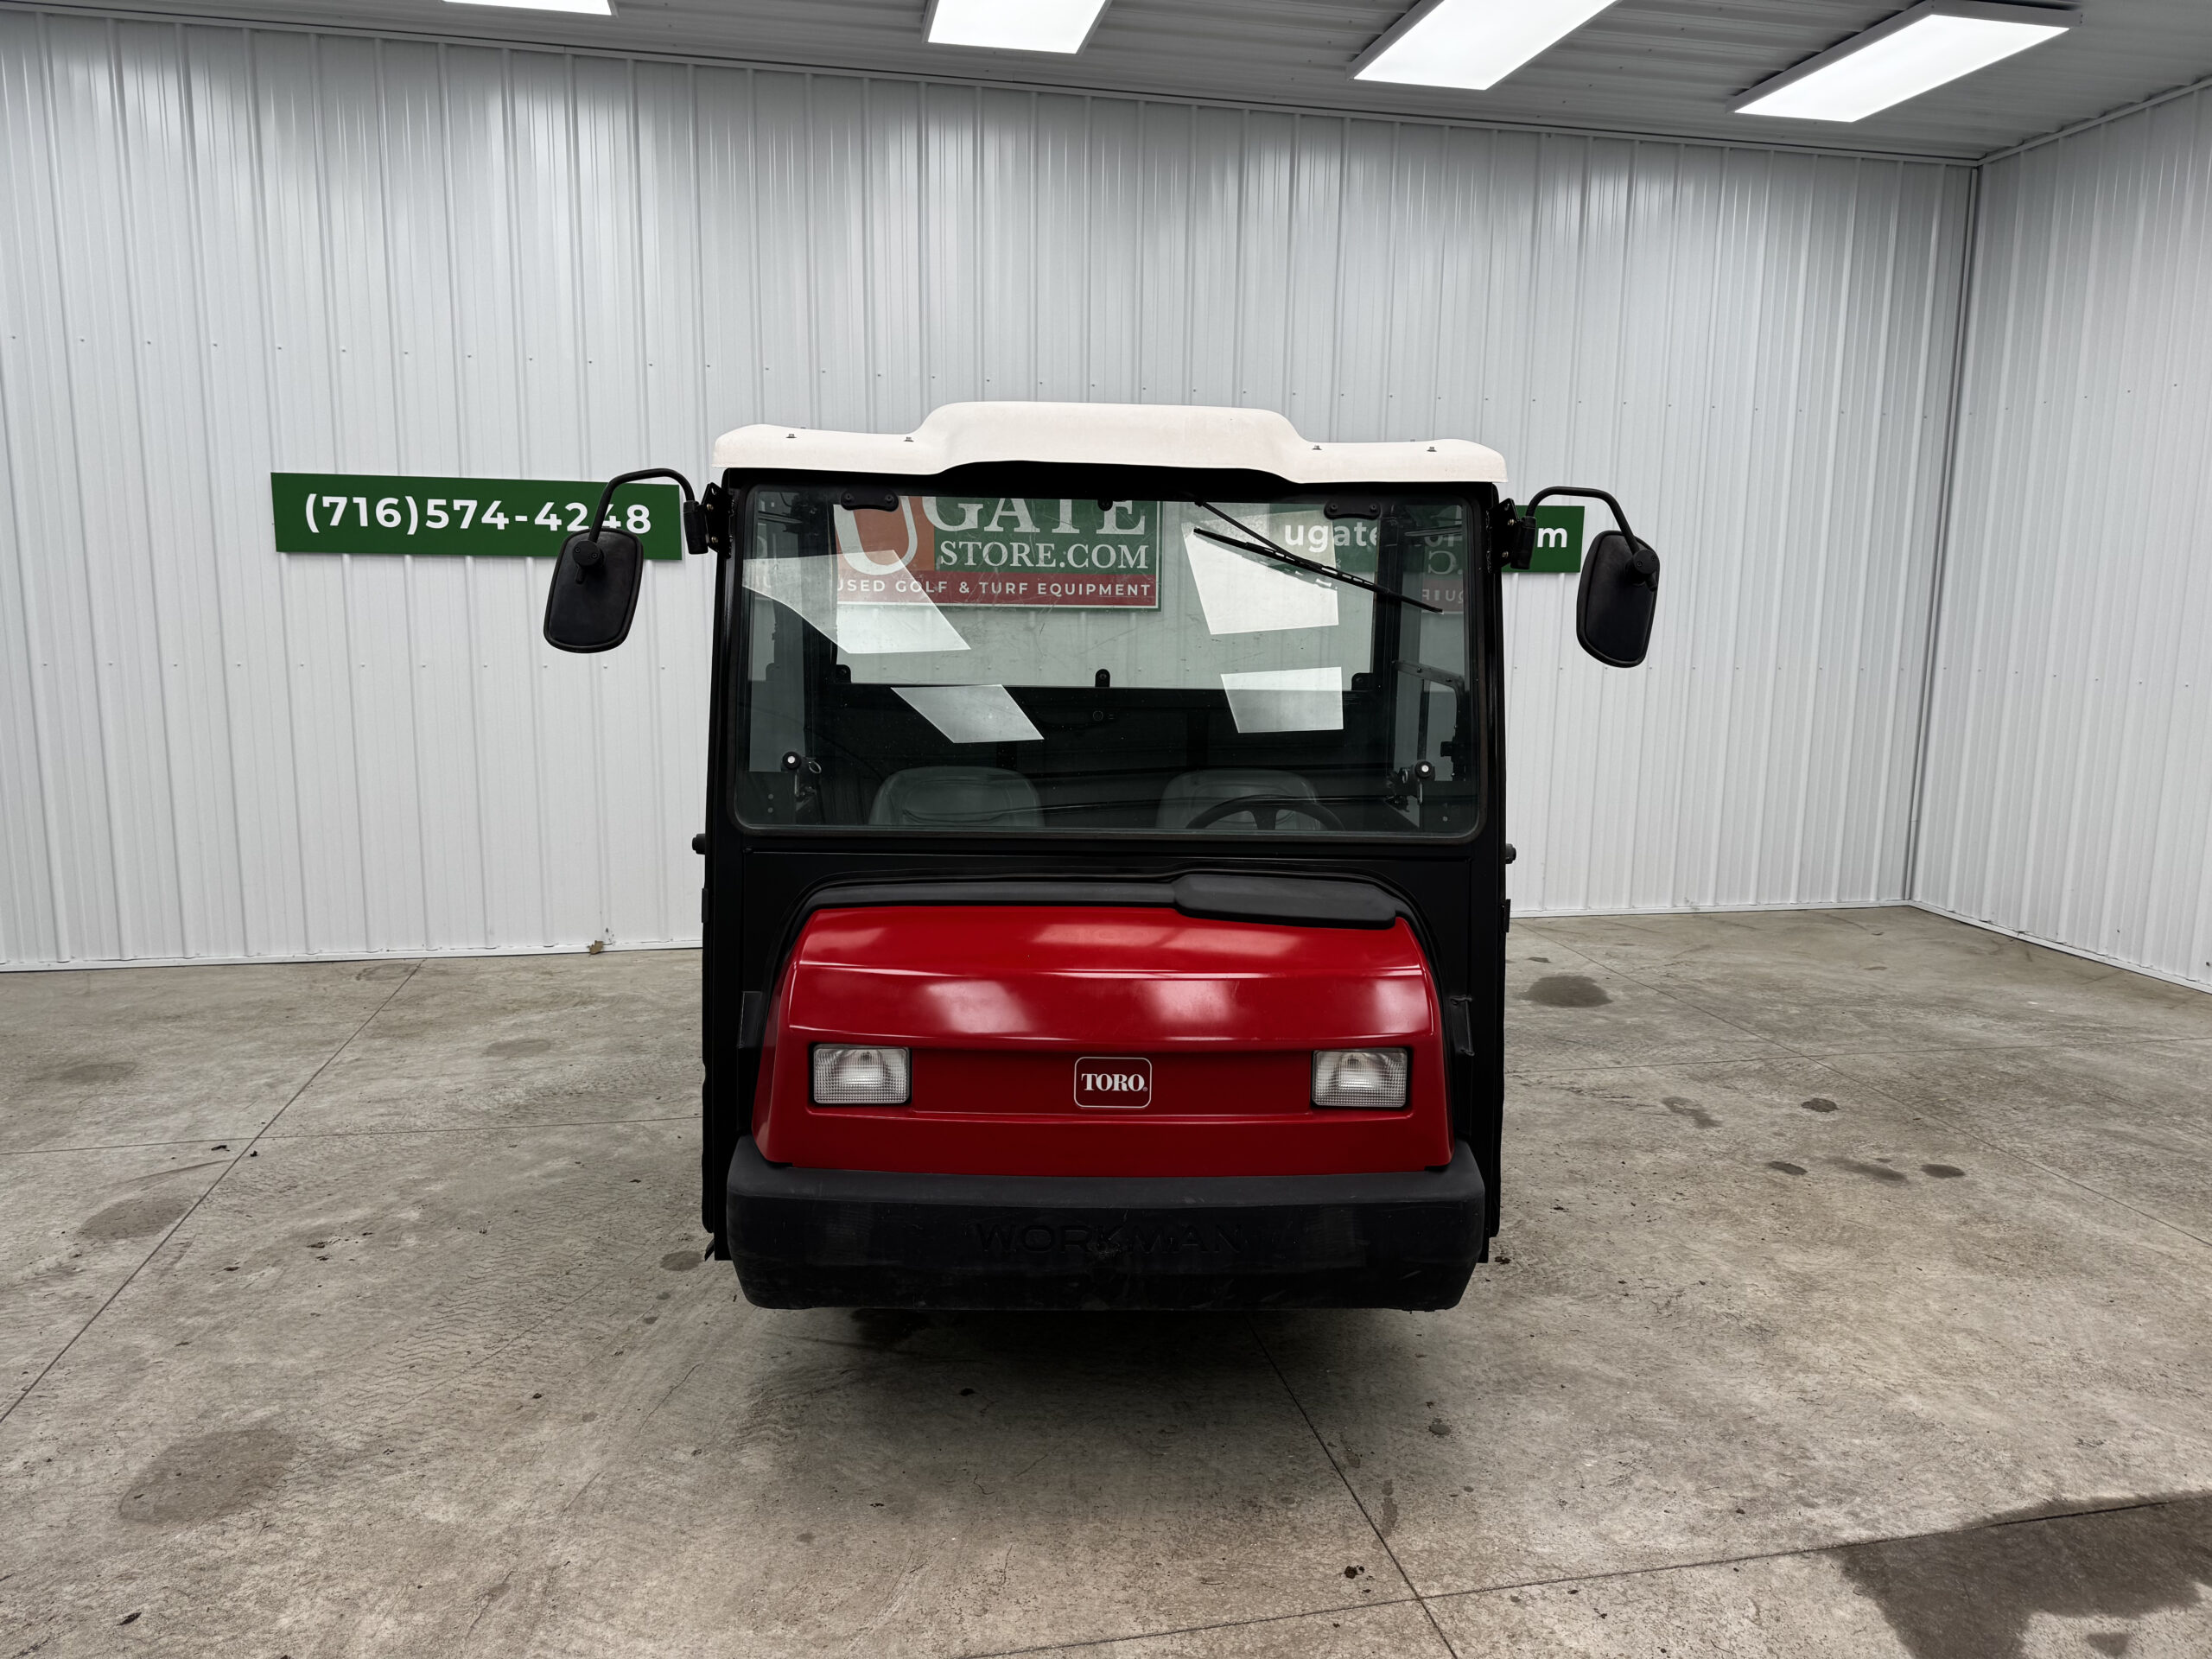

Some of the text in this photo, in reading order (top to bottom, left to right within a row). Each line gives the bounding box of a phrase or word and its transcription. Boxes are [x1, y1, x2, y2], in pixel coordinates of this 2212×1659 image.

[305, 493, 652, 535] (716)574-4248
[940, 540, 1149, 569] STORE.COM
[895, 580, 948, 593] GOLF
[959, 582, 969, 594] &
[979, 582, 1028, 594] TURF
[1038, 582, 1151, 597] EQUIPMENT
[1081, 1073, 1145, 1092] TORO
[976, 1224, 1244, 1254] WORKMAN
